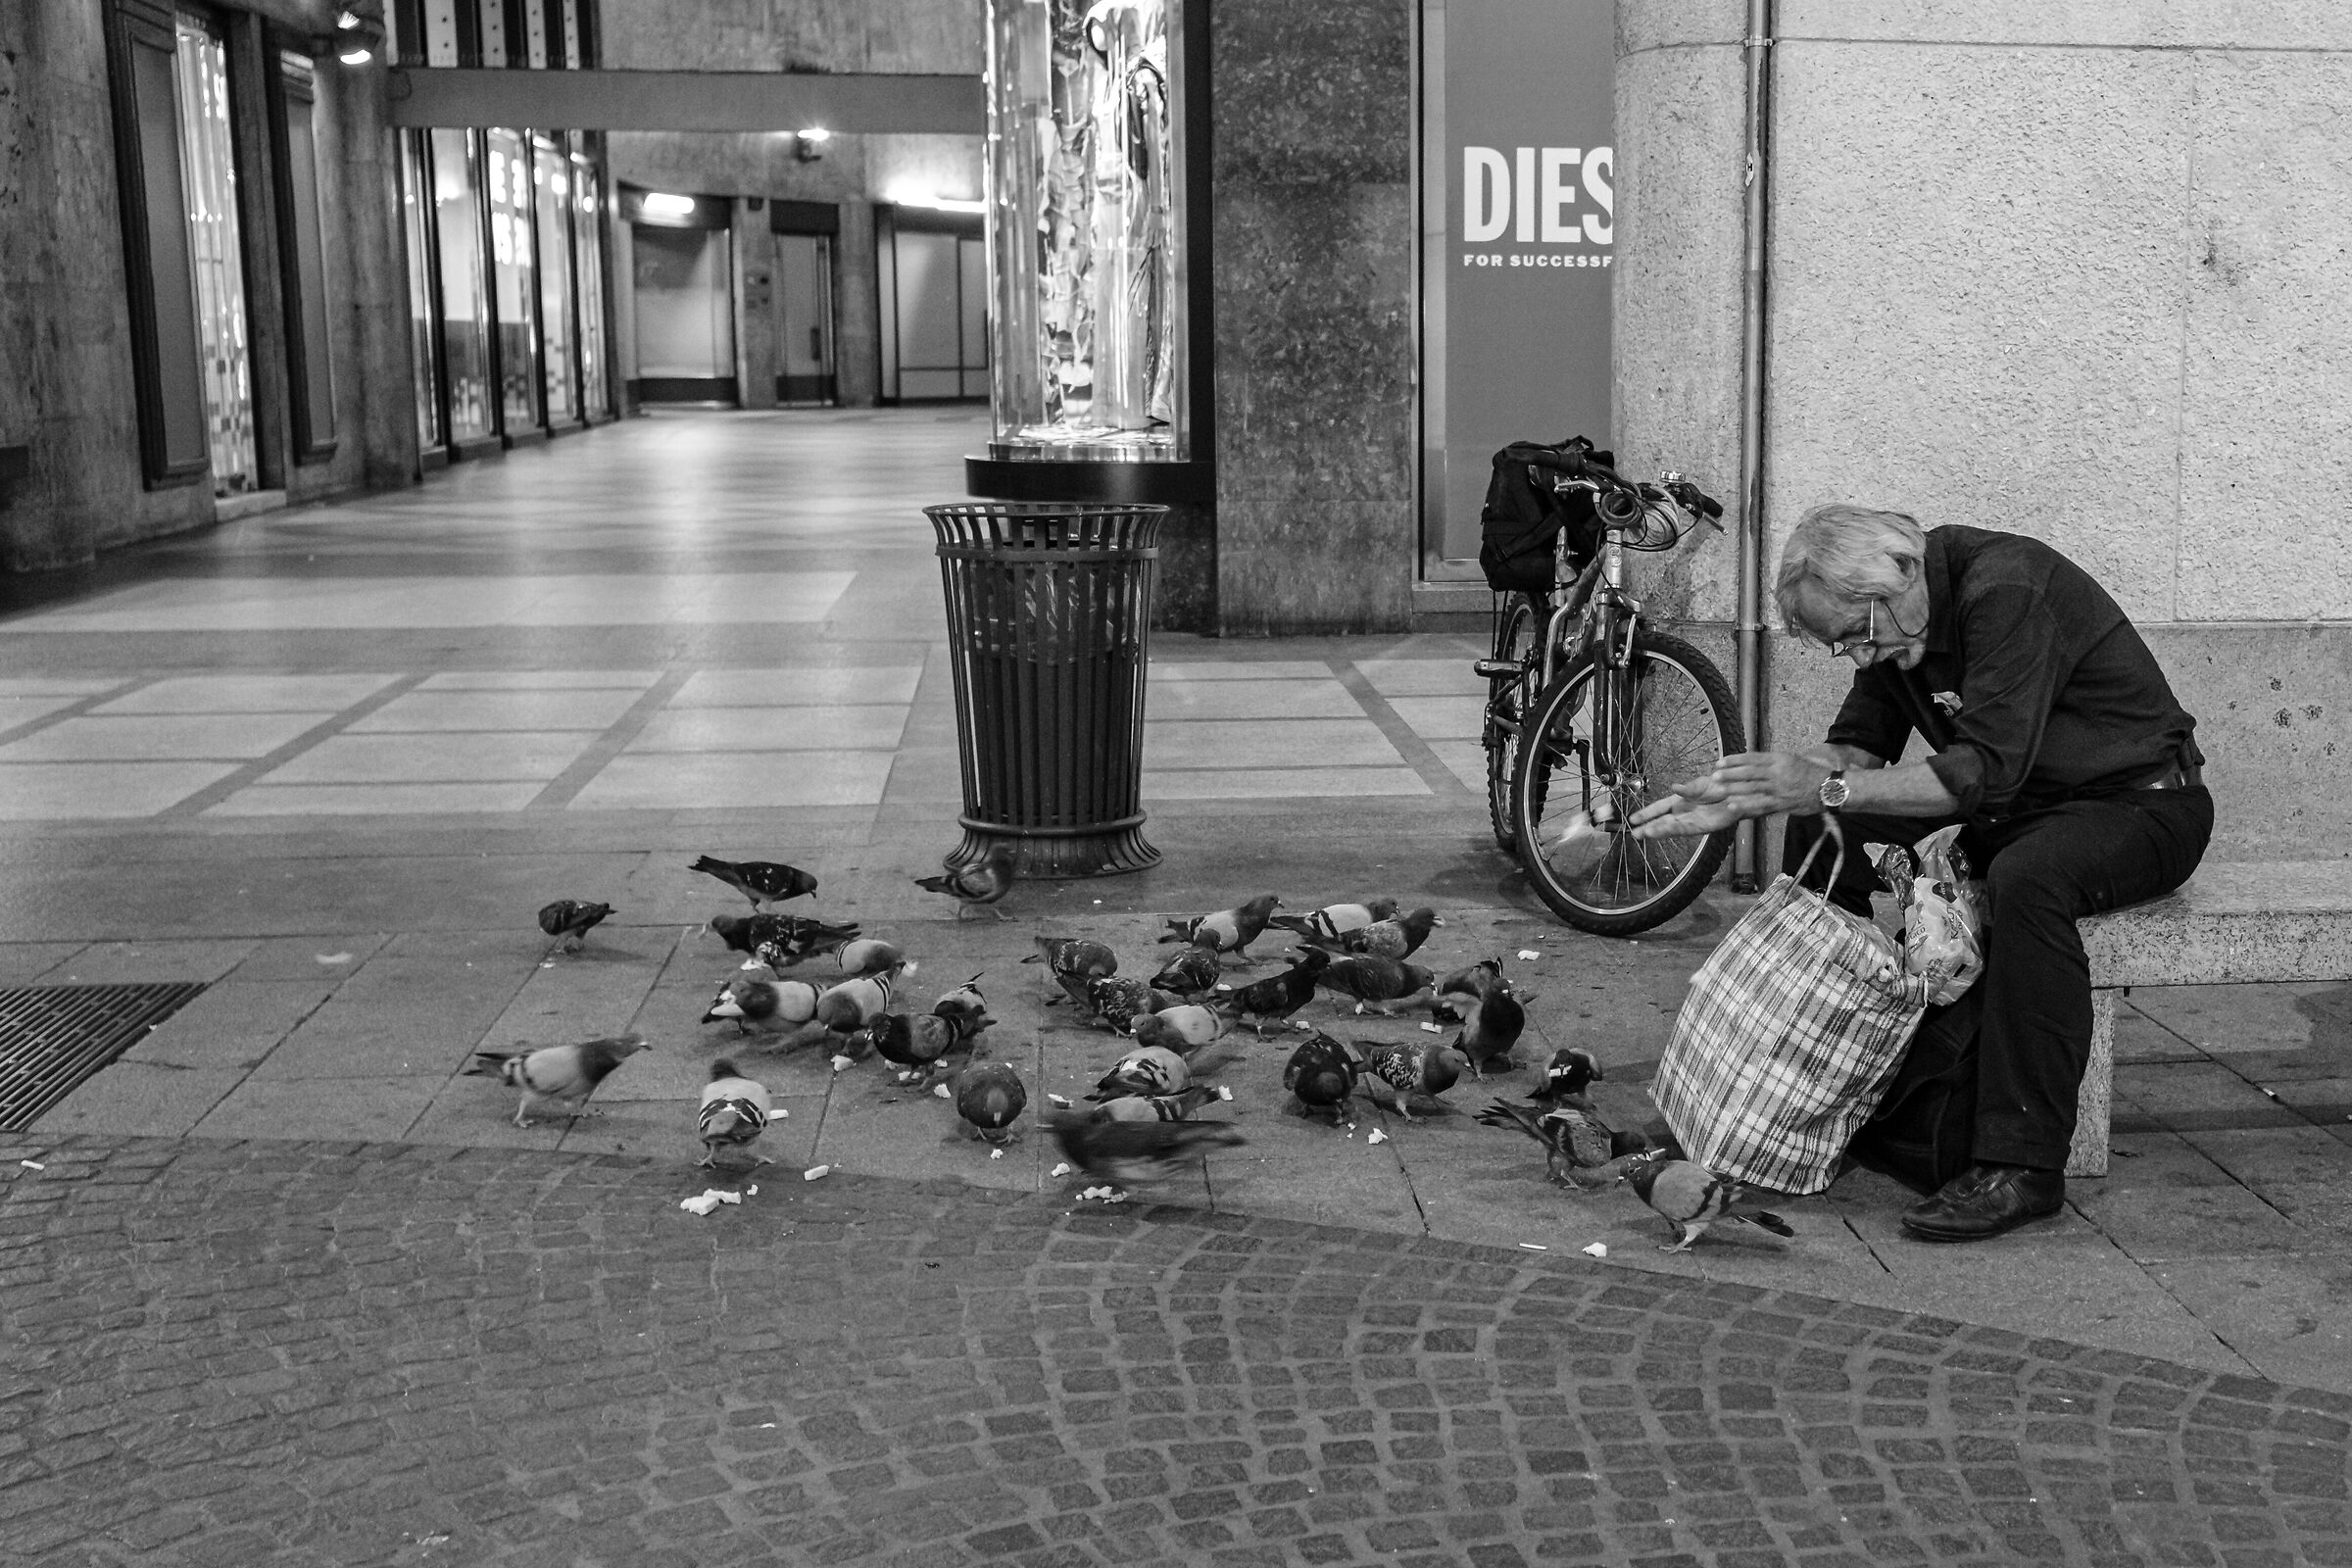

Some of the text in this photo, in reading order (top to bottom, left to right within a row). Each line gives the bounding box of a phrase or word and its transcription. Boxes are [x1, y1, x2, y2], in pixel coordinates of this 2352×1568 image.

[1464, 146, 1613, 244] DIES
[1464, 255, 1613, 268] FOR SUCCESSF
